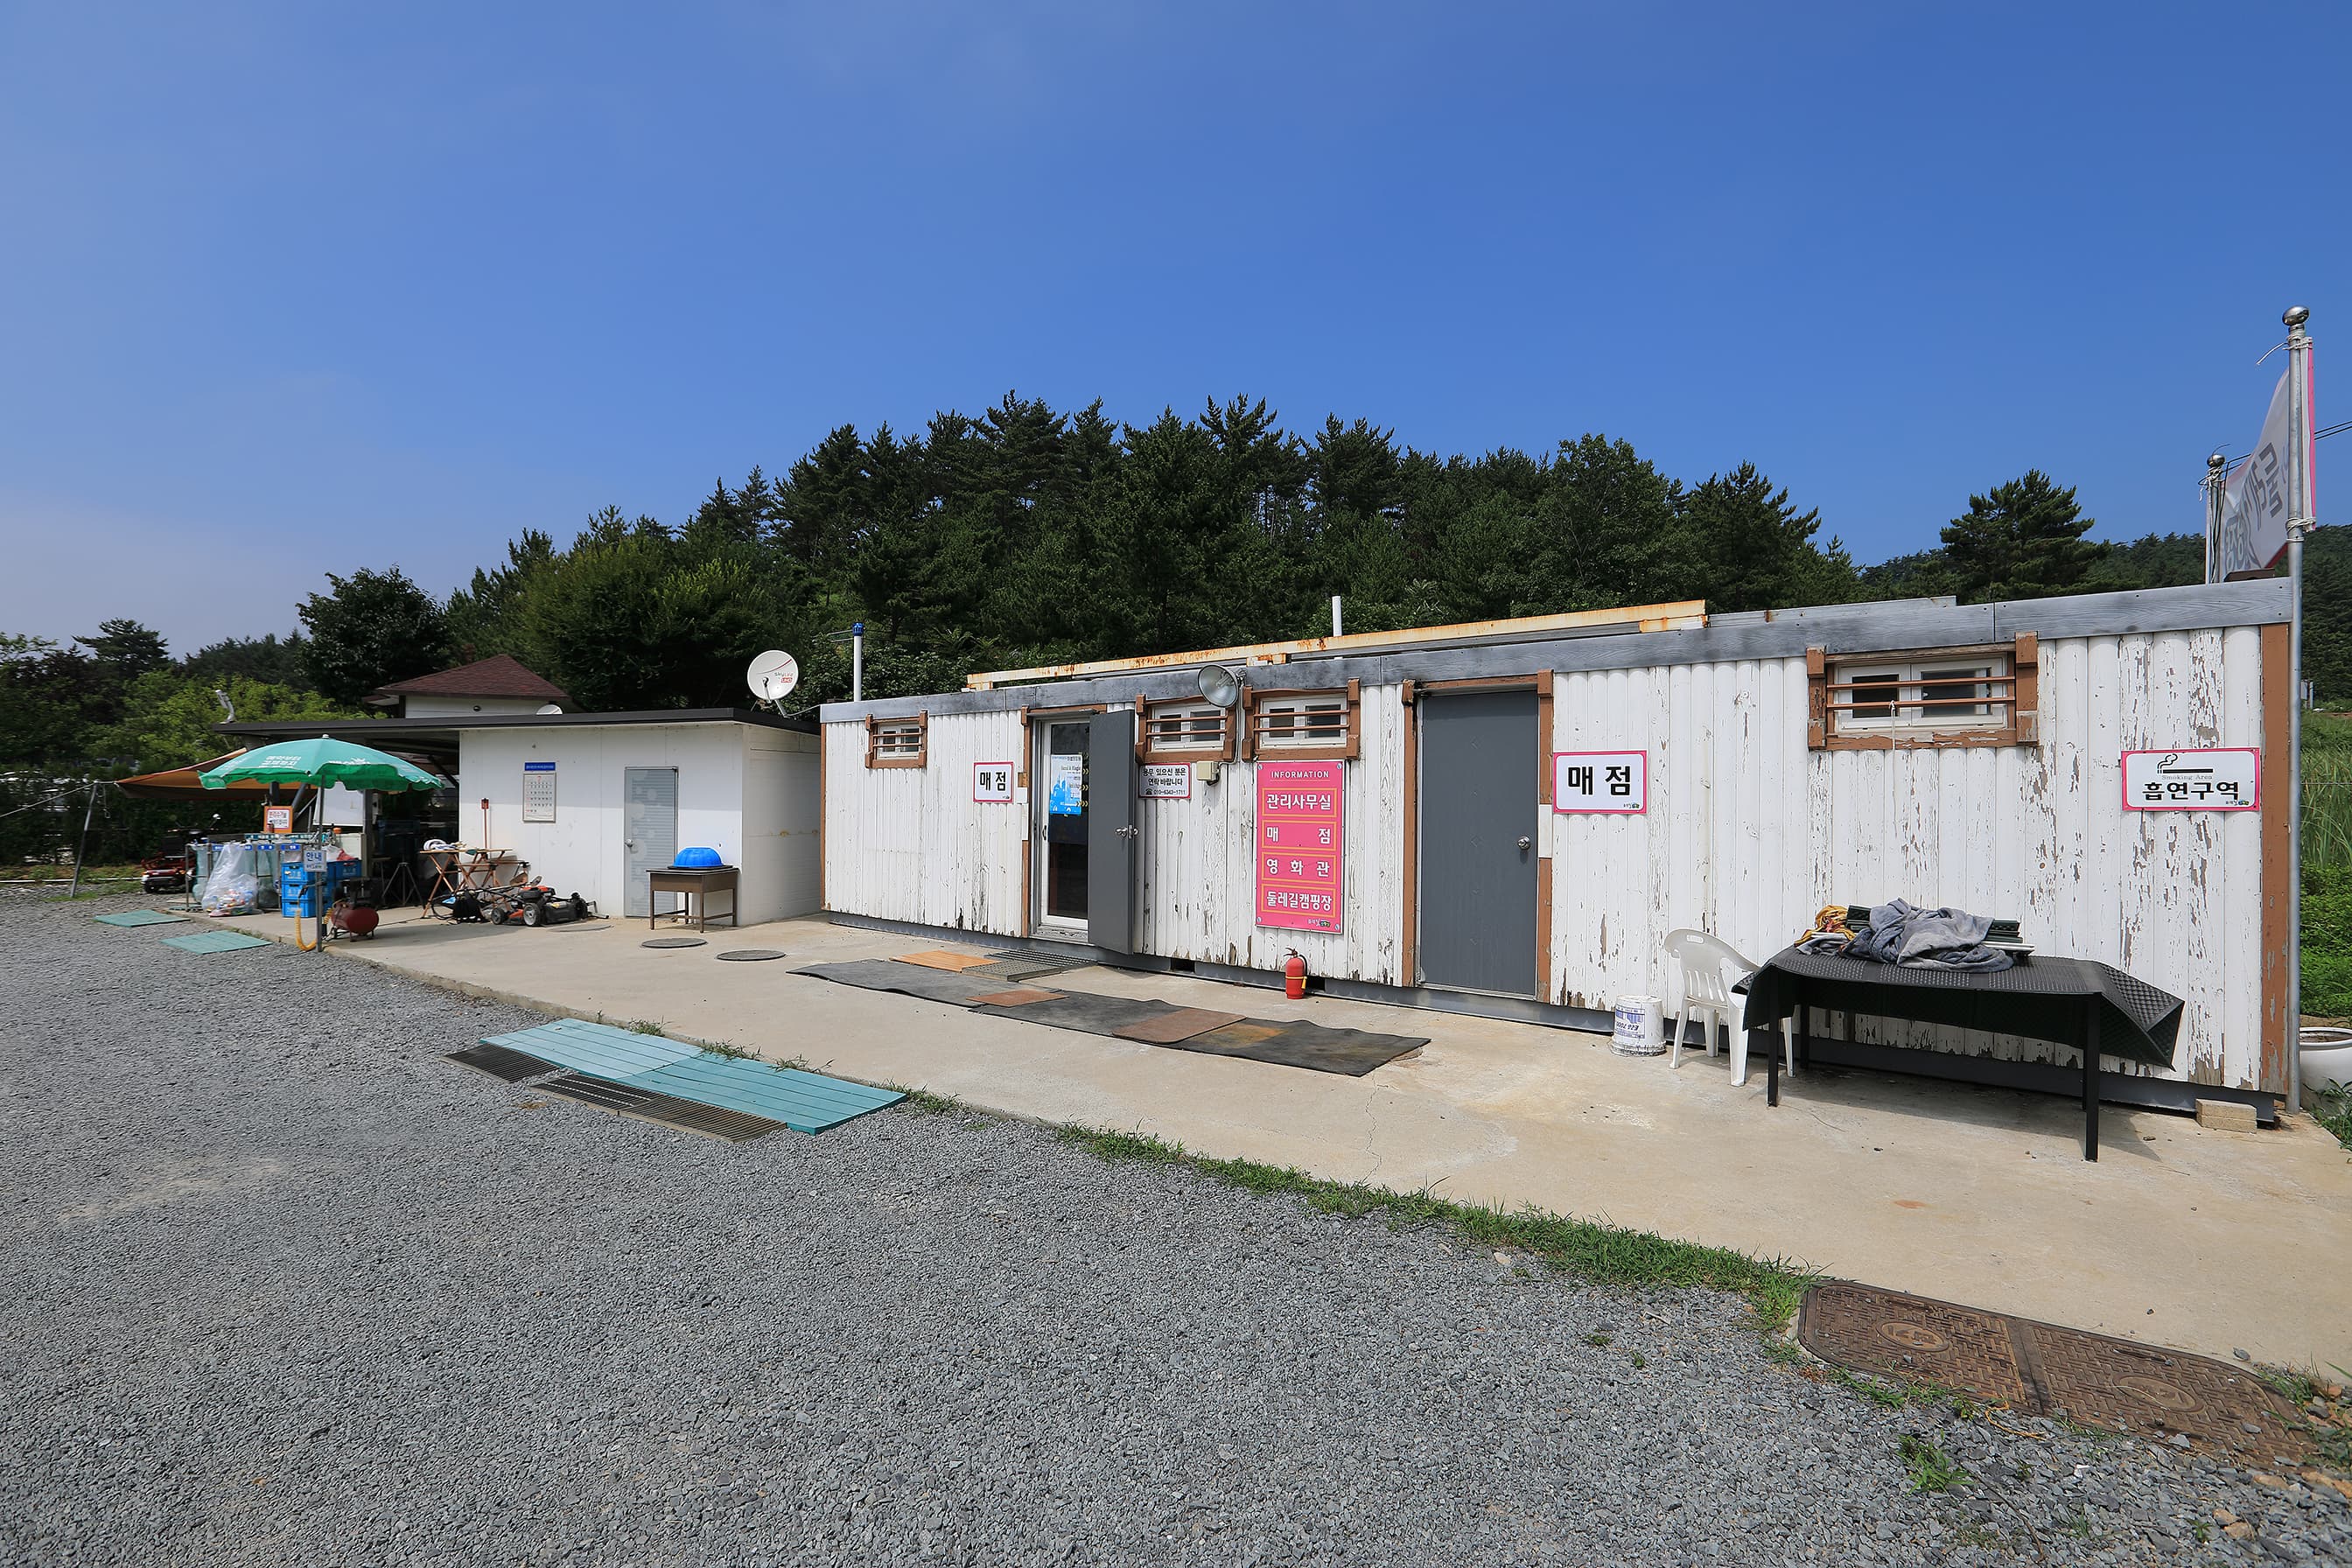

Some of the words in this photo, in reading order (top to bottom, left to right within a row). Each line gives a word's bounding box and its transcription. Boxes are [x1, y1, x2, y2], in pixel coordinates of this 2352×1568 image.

[1174, 767, 1186, 776] 분은
[1567, 765, 1631, 796] 매점
[980, 772, 1006, 791] 매점
[2142, 781, 2239, 801] 흡연구역
[1266, 794, 1331, 810] 관리사무실
[306, 851, 322, 862] 안내
[1266, 891, 1333, 911] 둘레길캠핑장
